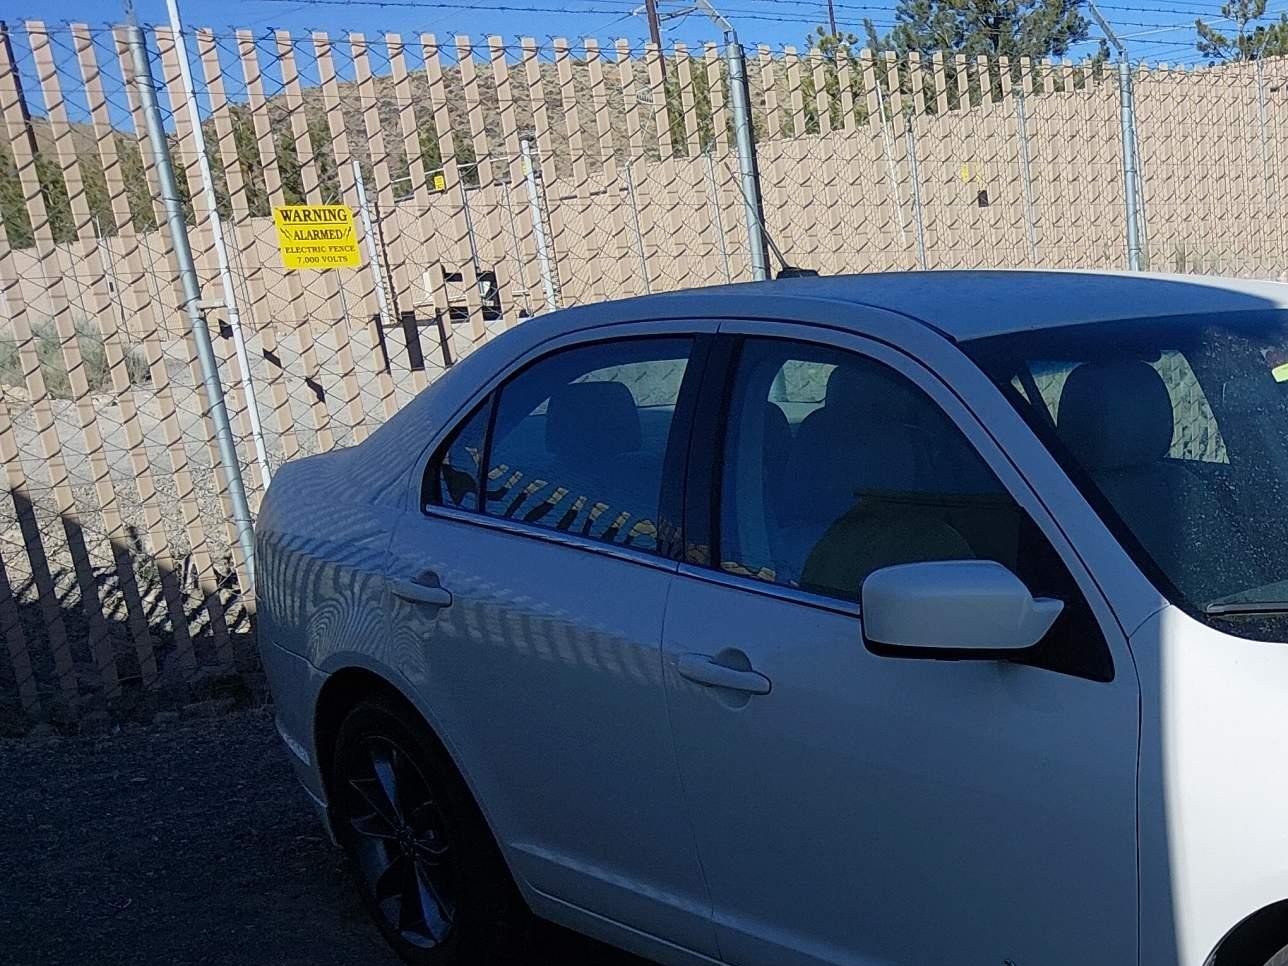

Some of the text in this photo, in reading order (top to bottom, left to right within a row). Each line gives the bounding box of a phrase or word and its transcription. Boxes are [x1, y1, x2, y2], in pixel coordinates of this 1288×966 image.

[280, 208, 348, 222] WARNING
[294, 229, 343, 241] ALARMED
[285, 245, 356, 254] ELECTRIC FENCE
[321, 255, 348, 263] VOLTS
